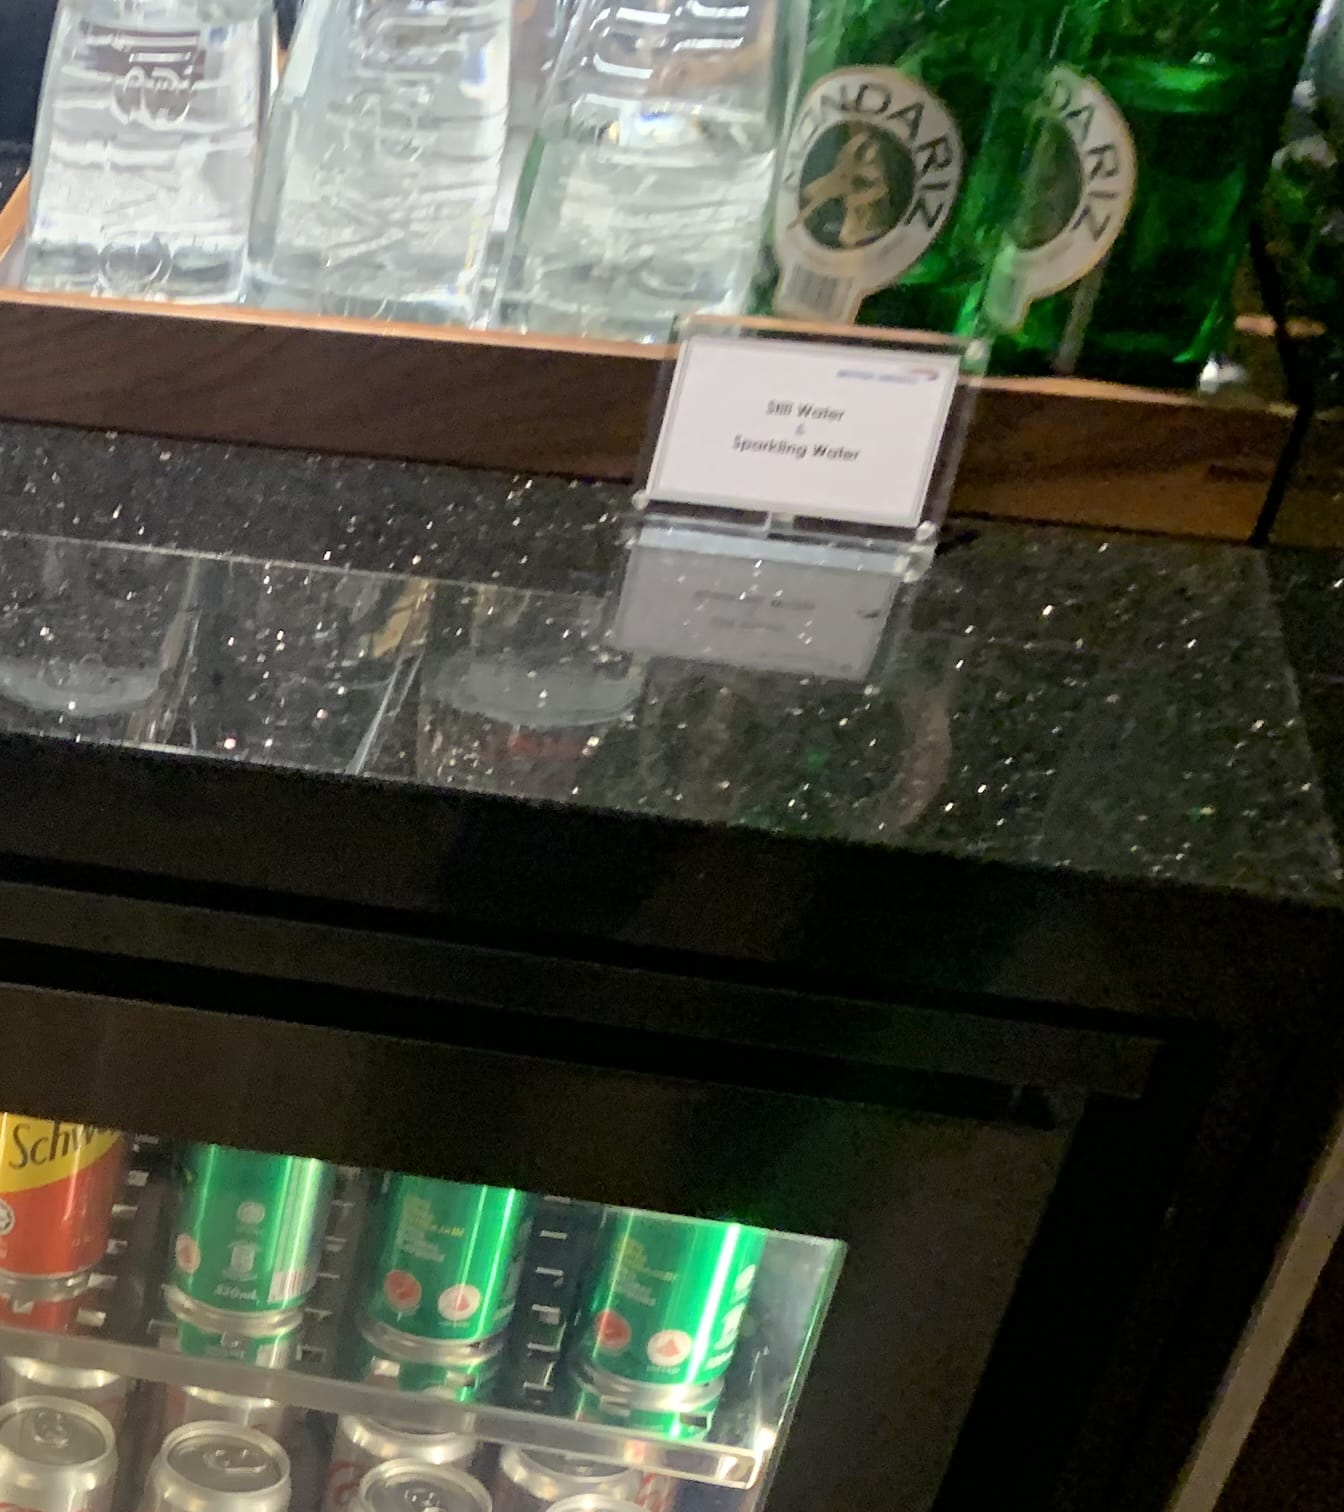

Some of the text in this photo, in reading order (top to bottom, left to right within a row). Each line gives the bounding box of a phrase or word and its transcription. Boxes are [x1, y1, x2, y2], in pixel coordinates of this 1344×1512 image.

[767, 399, 844, 421] Still Water
[733, 434, 860, 461] Sparkling Water
